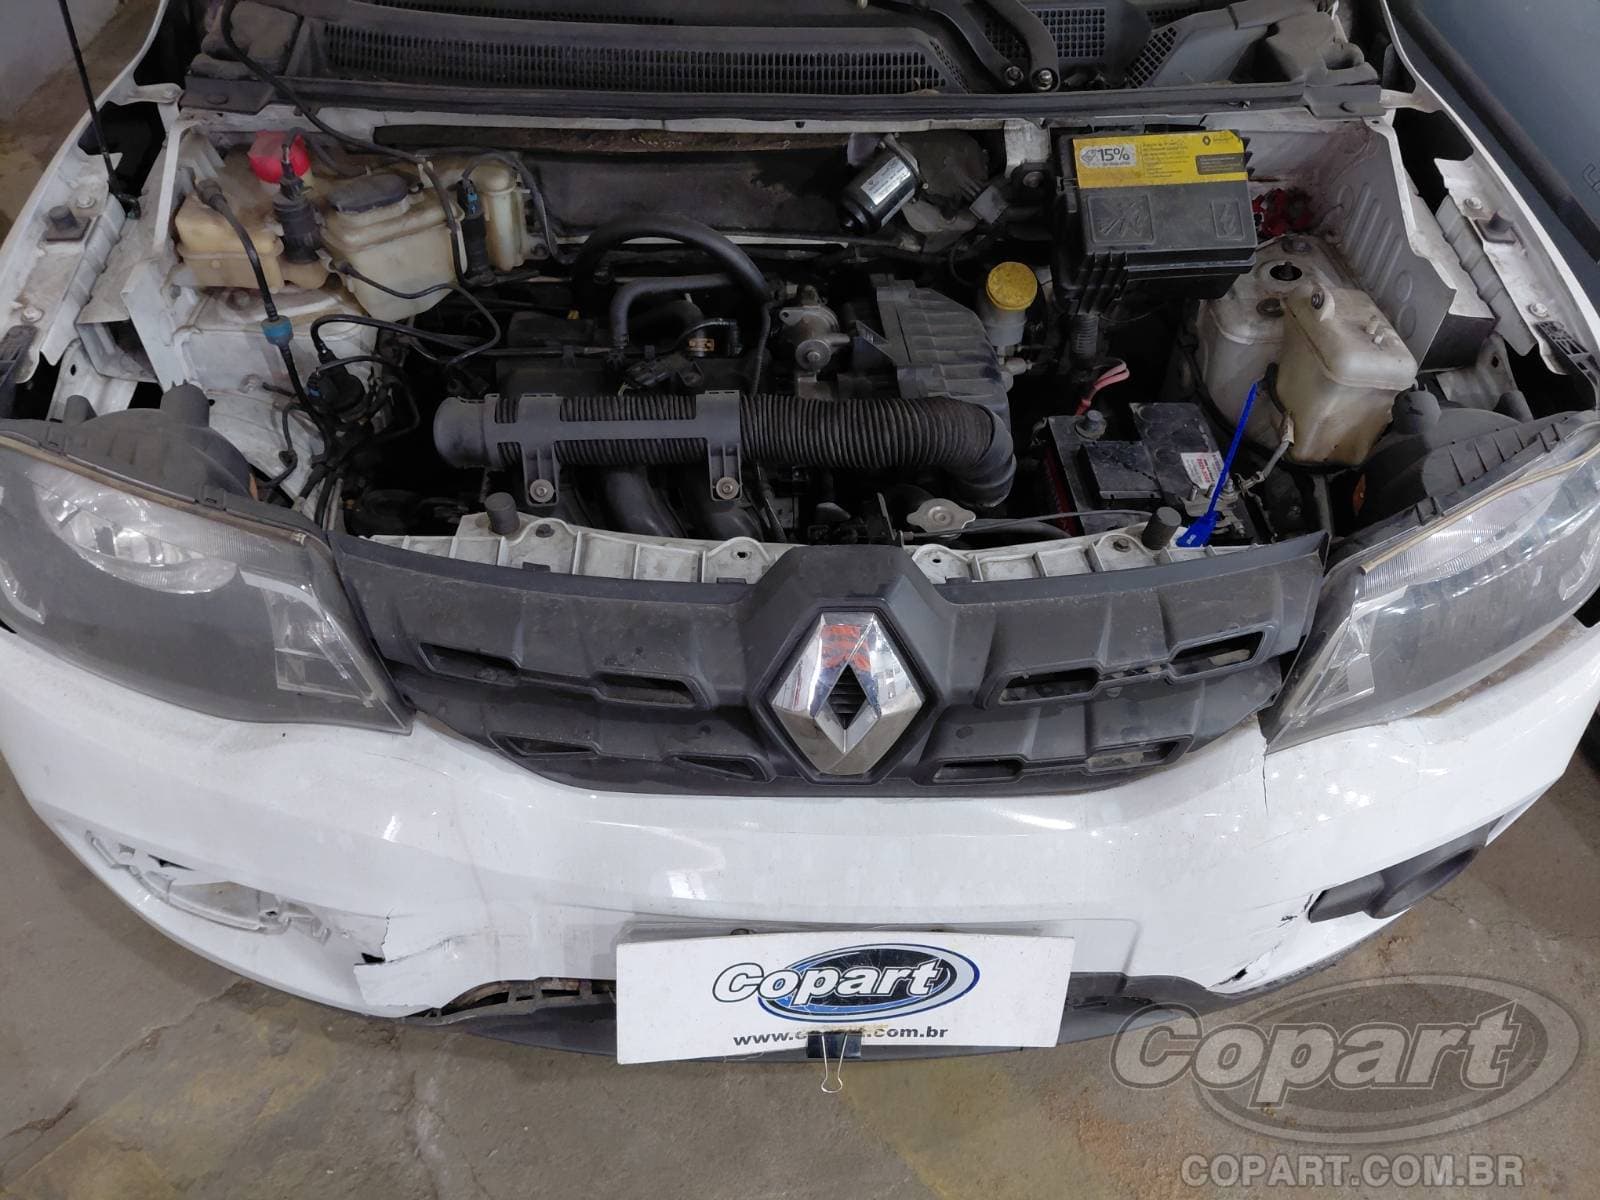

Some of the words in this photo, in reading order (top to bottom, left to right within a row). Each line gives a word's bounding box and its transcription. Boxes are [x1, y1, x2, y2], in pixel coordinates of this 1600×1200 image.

[1097, 147, 1130, 161] 15%
[713, 960, 944, 1006] Copart
[734, 1026, 948, 1046] www.c.com.br
